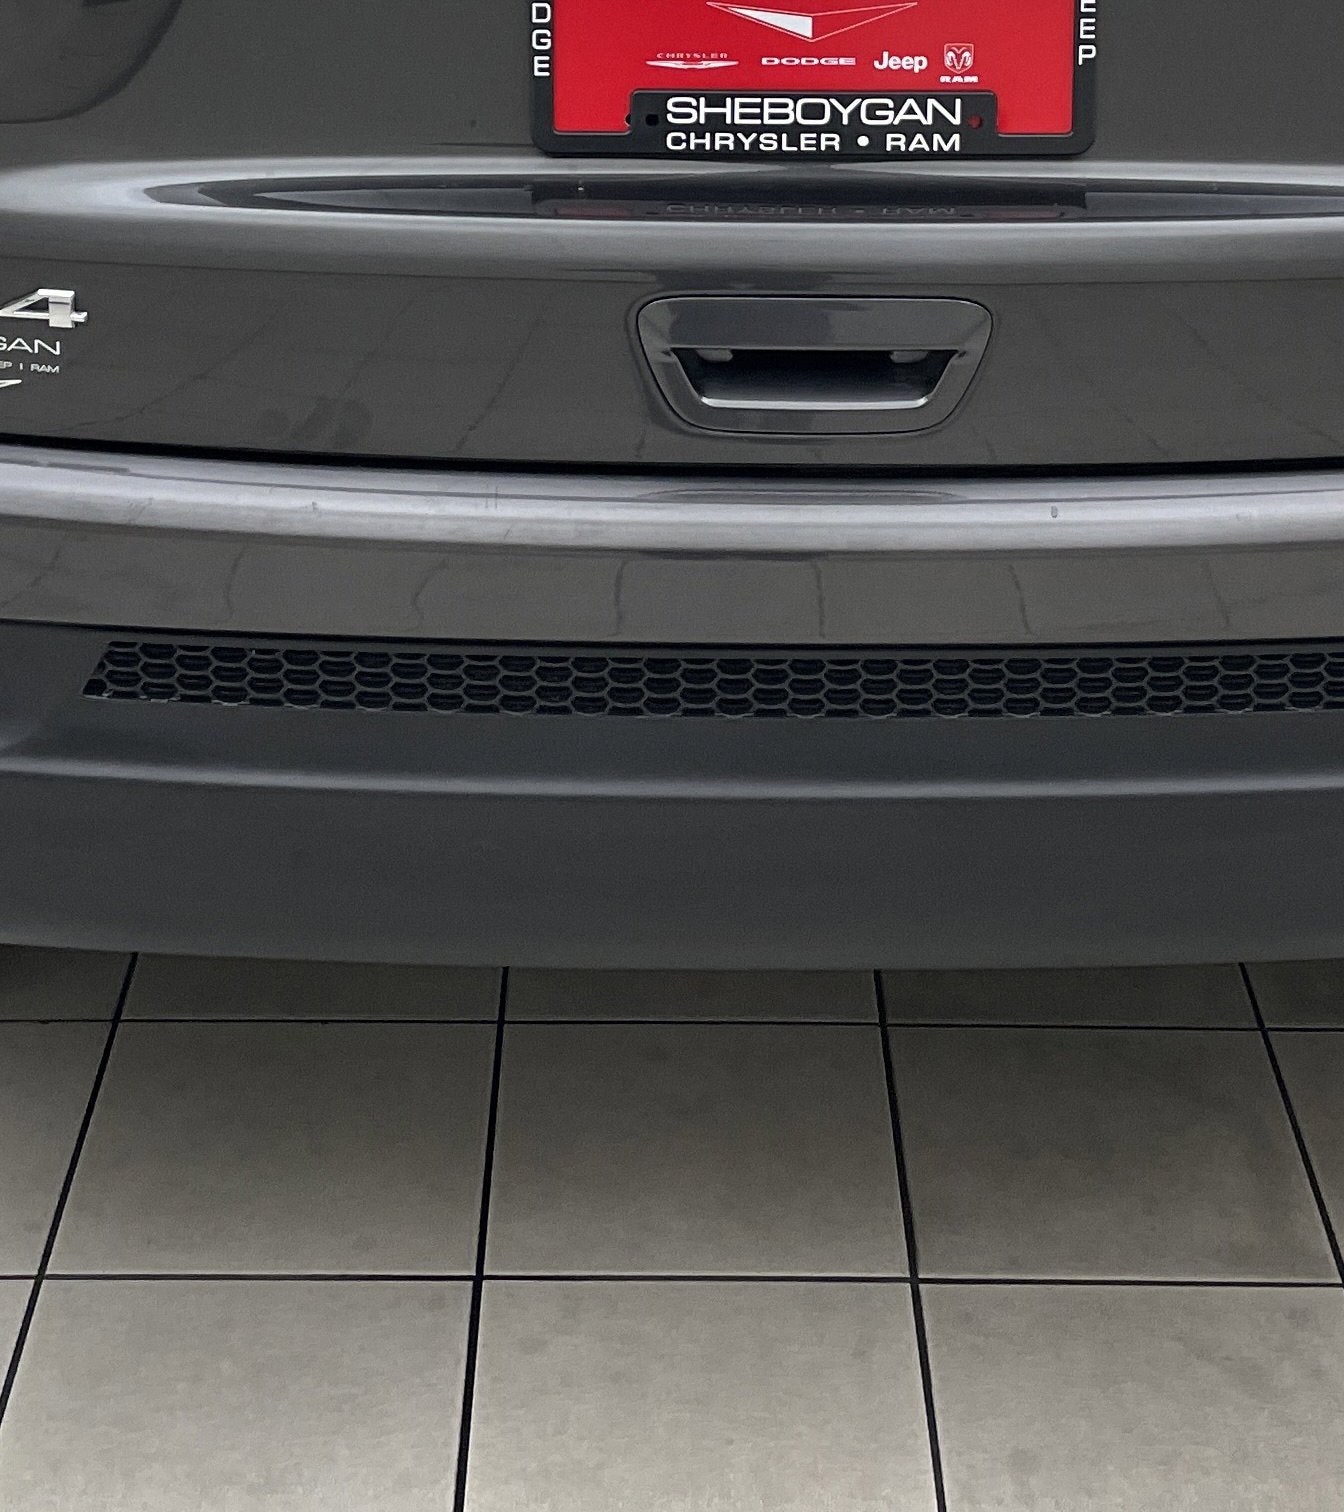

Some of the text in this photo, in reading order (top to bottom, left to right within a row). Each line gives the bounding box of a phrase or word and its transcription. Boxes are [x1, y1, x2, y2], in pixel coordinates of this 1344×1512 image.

[761, 57, 856, 65] DODGE
[873, 51, 928, 73] Jeep
[666, 97, 962, 127] SHEBOYGAN
[666, 132, 960, 152] CHRYSLER RAM
[31, 364, 59, 373] RAM
